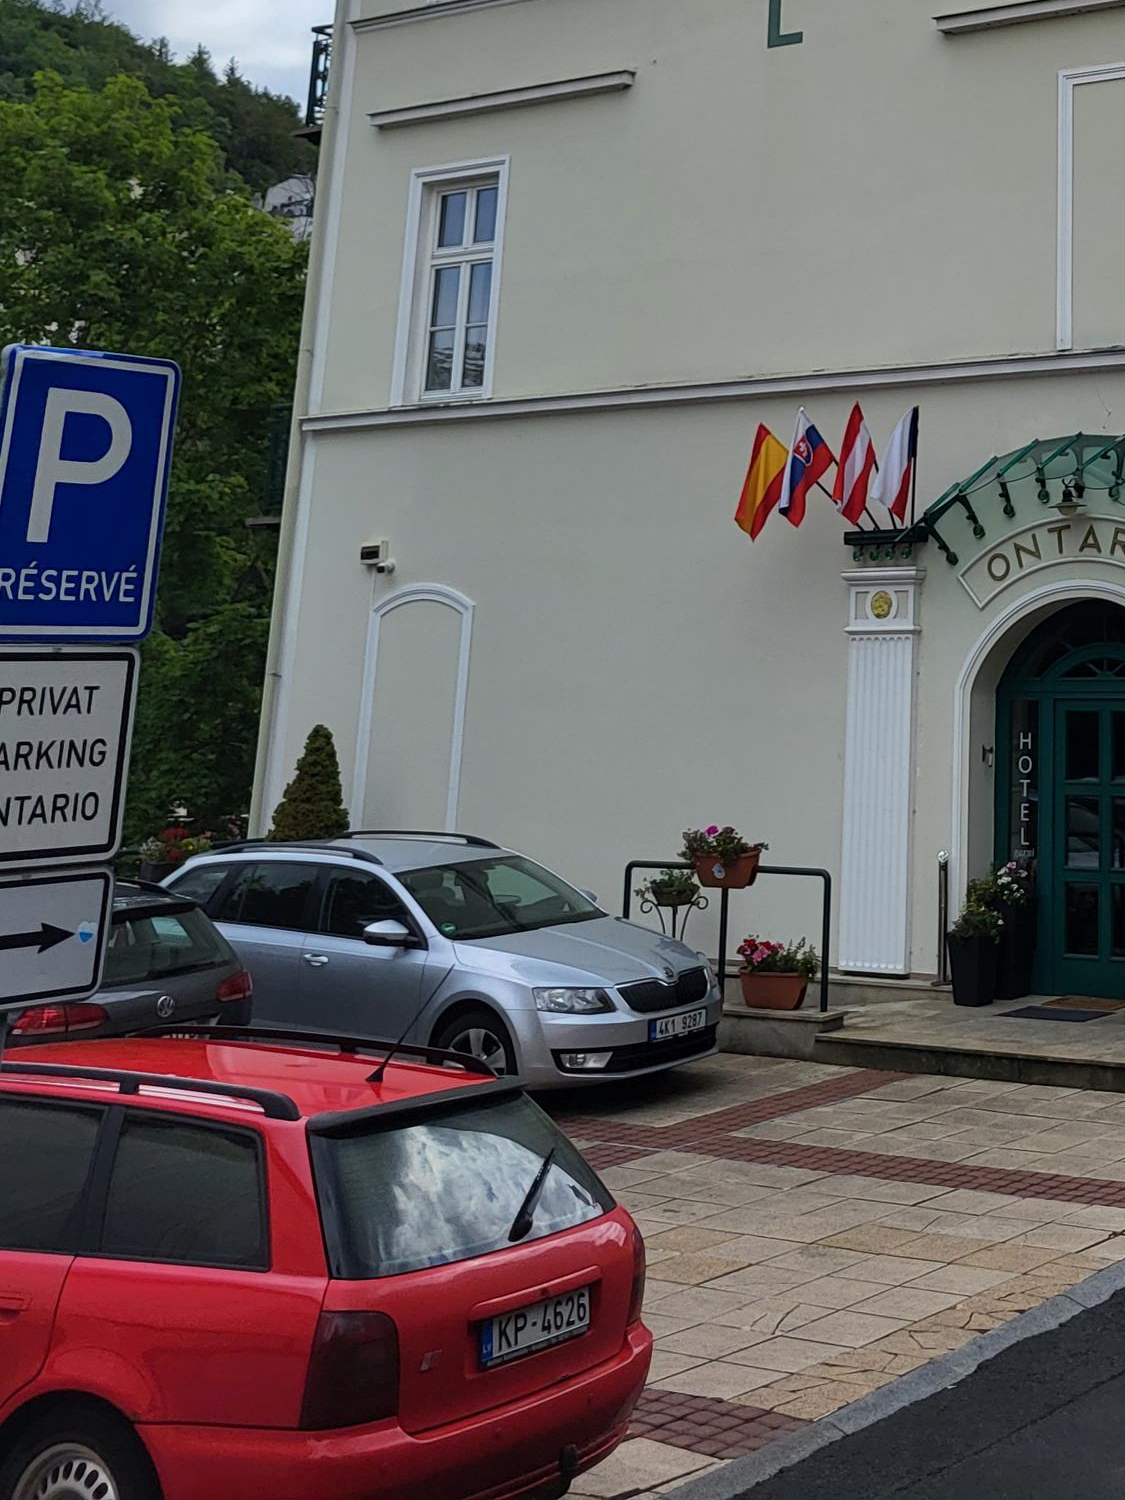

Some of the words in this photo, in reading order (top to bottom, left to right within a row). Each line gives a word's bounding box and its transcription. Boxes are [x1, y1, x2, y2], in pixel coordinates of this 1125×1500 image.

[26, 387, 133, 543] P
[0, 561, 138, 602] RÉSERVÉ
[0, 686, 100, 716] PRIVAT
[1018, 732, 1033, 845] HOTEL
[498, 1292, 587, 1350] KP-4626
